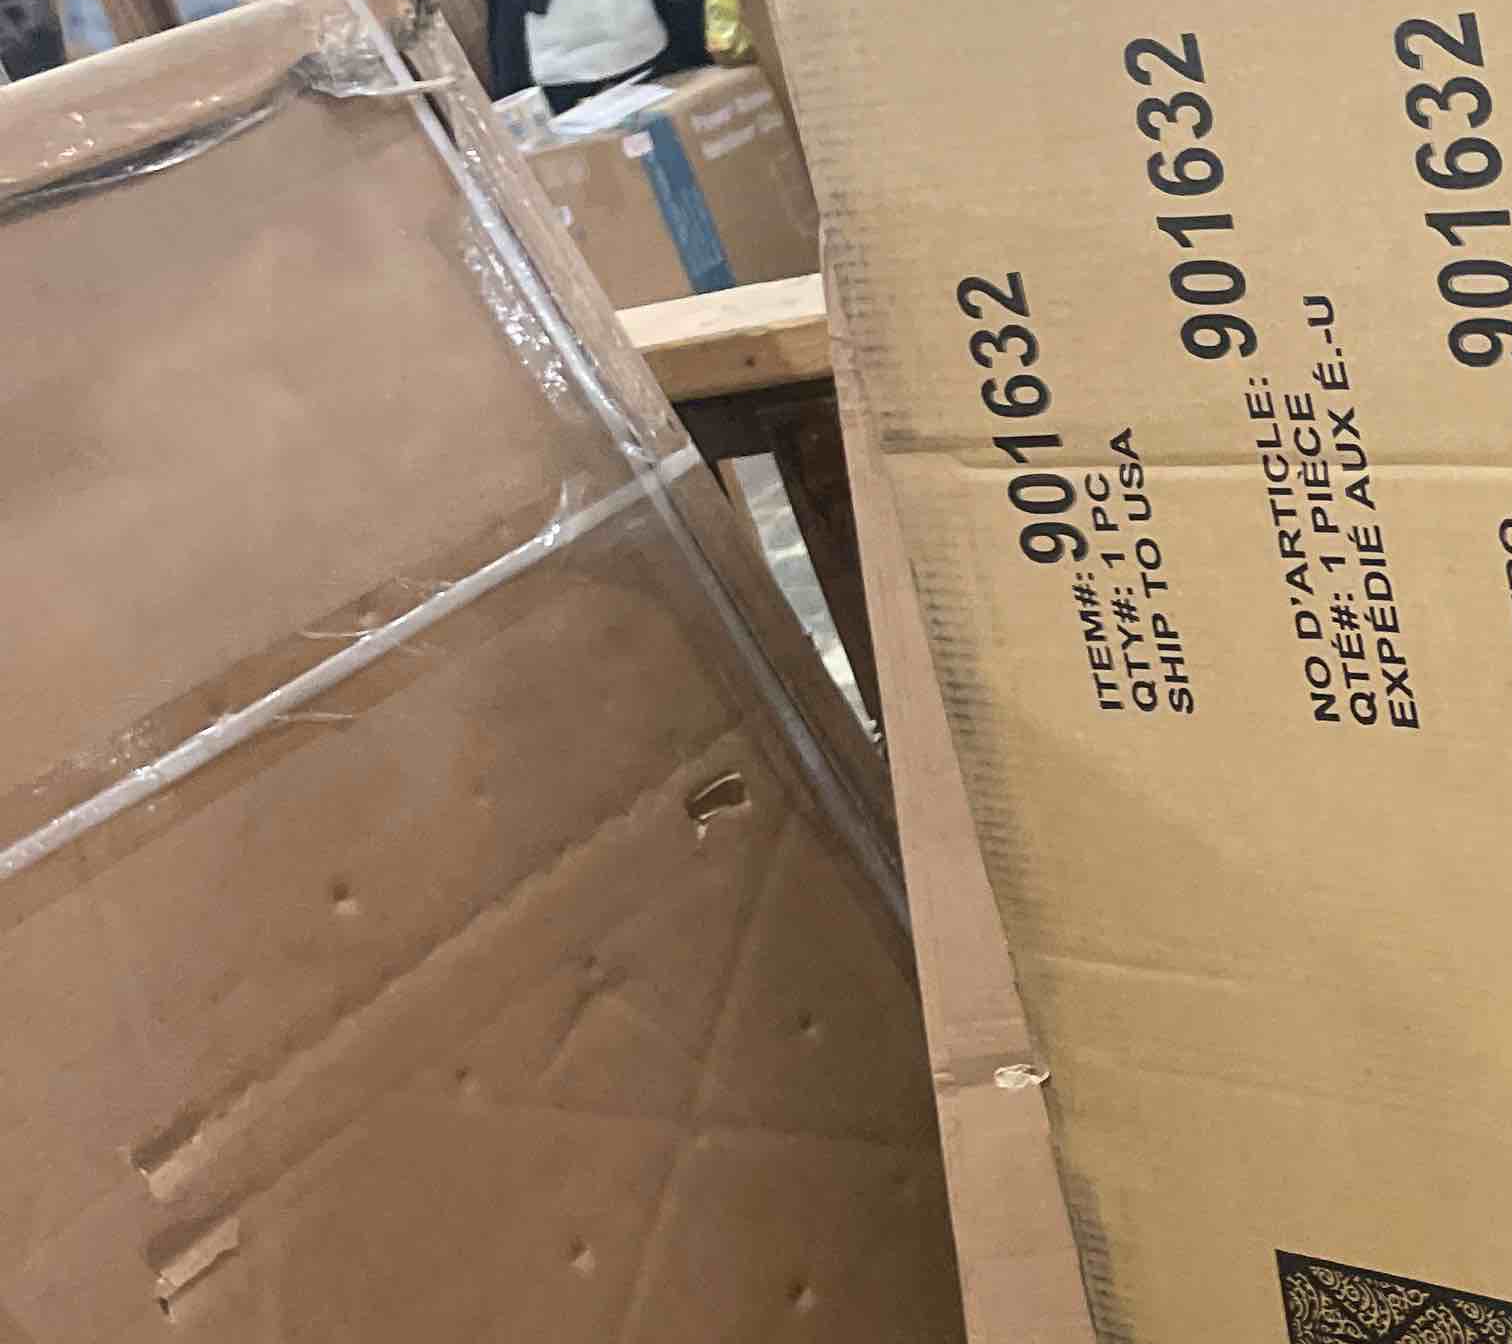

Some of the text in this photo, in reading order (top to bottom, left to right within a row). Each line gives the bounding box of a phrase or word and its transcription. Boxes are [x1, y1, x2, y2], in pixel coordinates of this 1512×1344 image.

[956, 271, 1124, 713] ITEM#: 901632
[1123, 32, 1341, 725] NO D'ARTICLE: 901632
[1331, 407, 1378, 511] AUX
[1083, 472, 1159, 714] QTY#: 1 PC
[1109, 427, 1195, 715] SHIP TO USA
[1284, 392, 1379, 728] QTÉ#: 1 PIÈCE
[1361, 524, 1421, 731] EXPÉDIÉ
